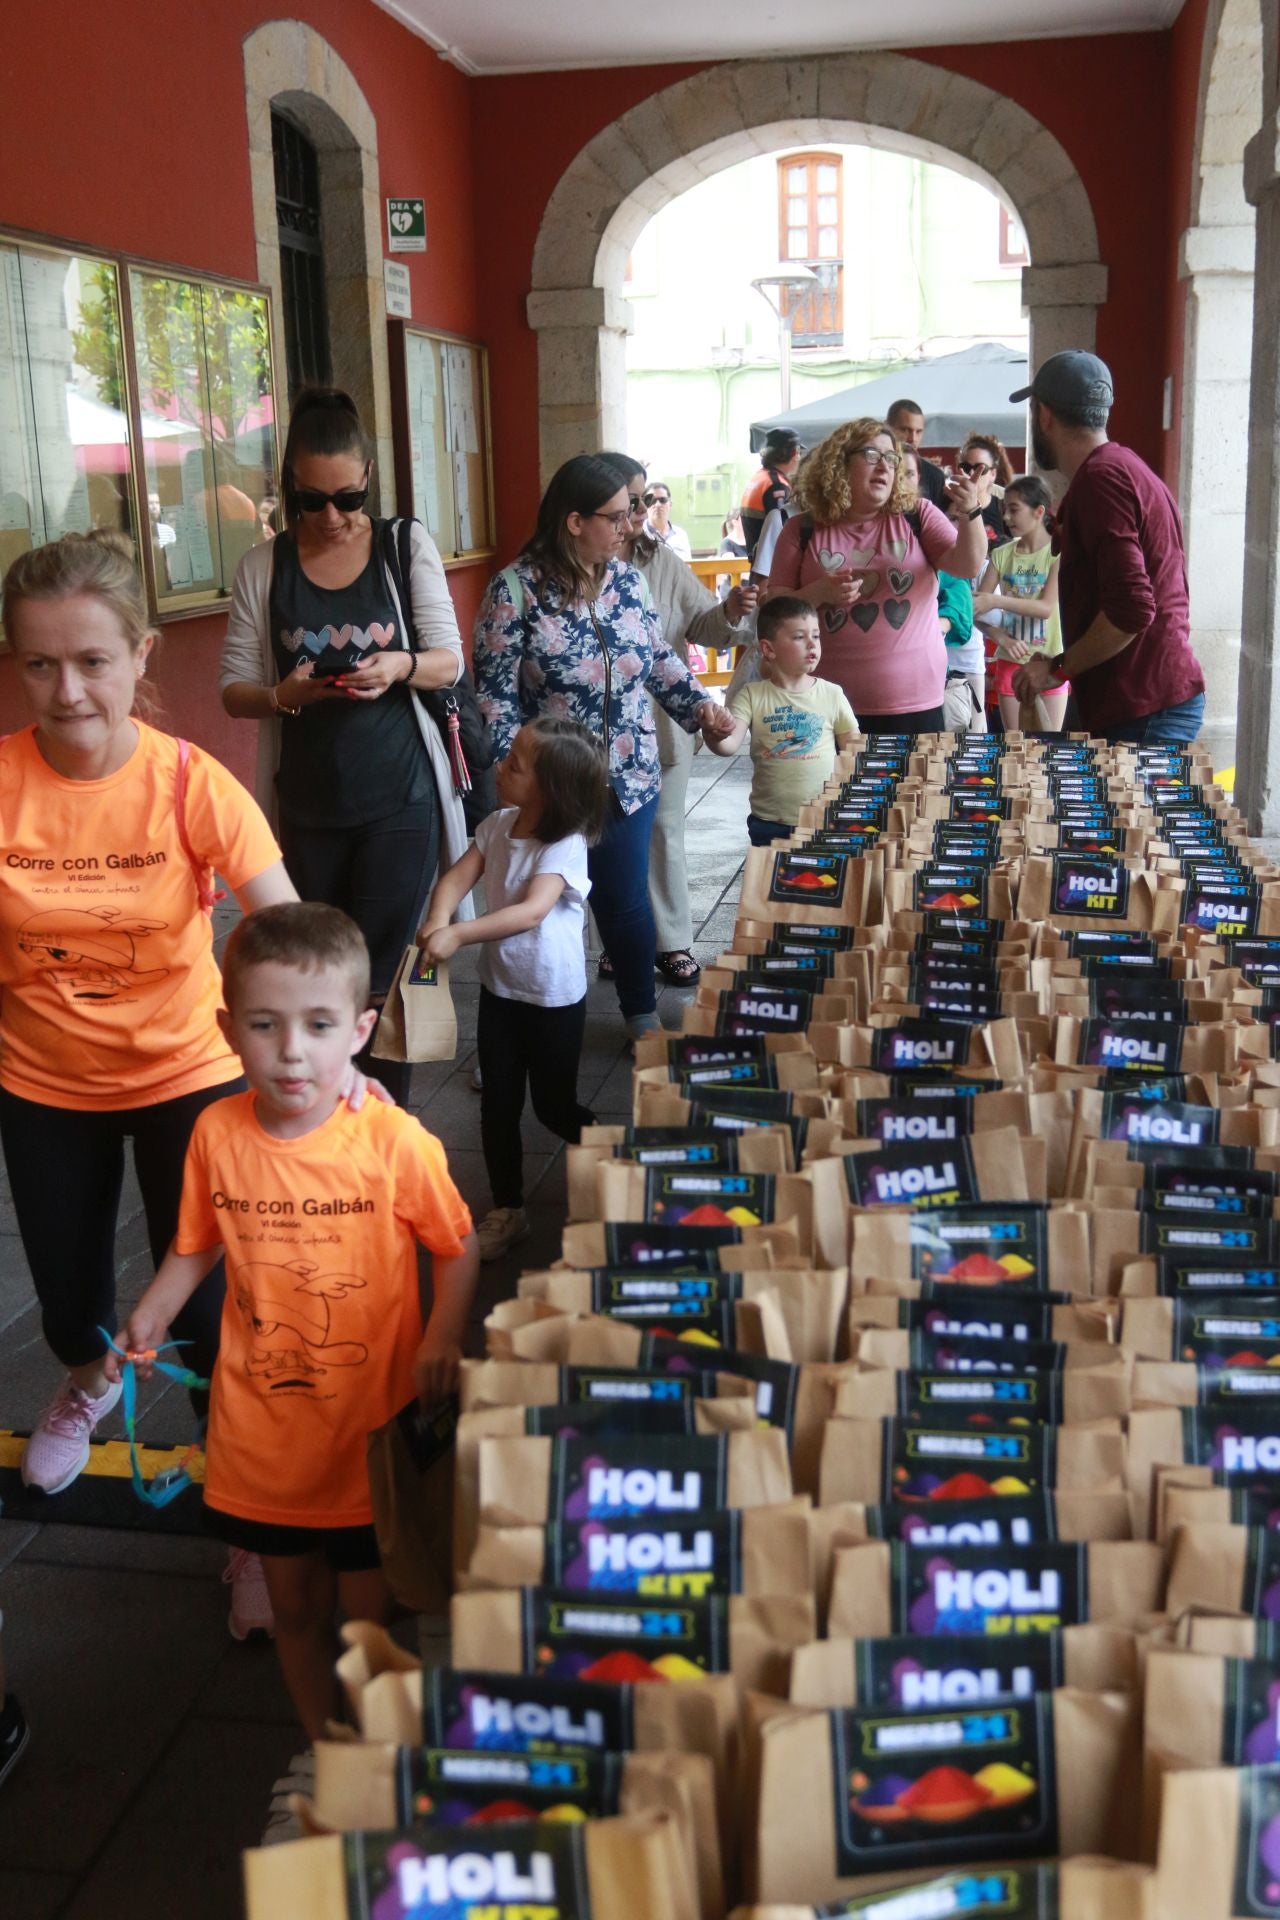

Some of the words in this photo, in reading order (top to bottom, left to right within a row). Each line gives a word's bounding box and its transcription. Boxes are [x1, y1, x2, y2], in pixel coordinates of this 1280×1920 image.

[390, 202, 410, 210] DEA
[6, 854, 55, 870] Corre
[62, 856, 99, 870] con
[106, 850, 166, 869] Galbán
[1069, 876, 1118, 893] HOLI
[1086, 895, 1117, 910] KIT
[1198, 902, 1248, 921] HOLI
[1216, 921, 1247, 935] KIT
[740, 1000, 798, 1021] HOLI
[894, 1040, 954, 1060] HOLI
[1102, 1036, 1166, 1062] HOLI
[883, 1116, 955, 1139] HOLI
[1128, 1114, 1200, 1144] HOLI
[876, 1162, 956, 1200] HOLI
[256, 1200, 295, 1214] con
[302, 1197, 374, 1216] Galbán
[588, 1468, 700, 1510] HOLI
[588, 1530, 712, 1572] HOLI
[638, 1572, 713, 1596] KIT
[935, 1569, 1059, 1610] HOLI
[470, 1694, 603, 1745] HOLI
[399, 1851, 554, 1907] HOLI
